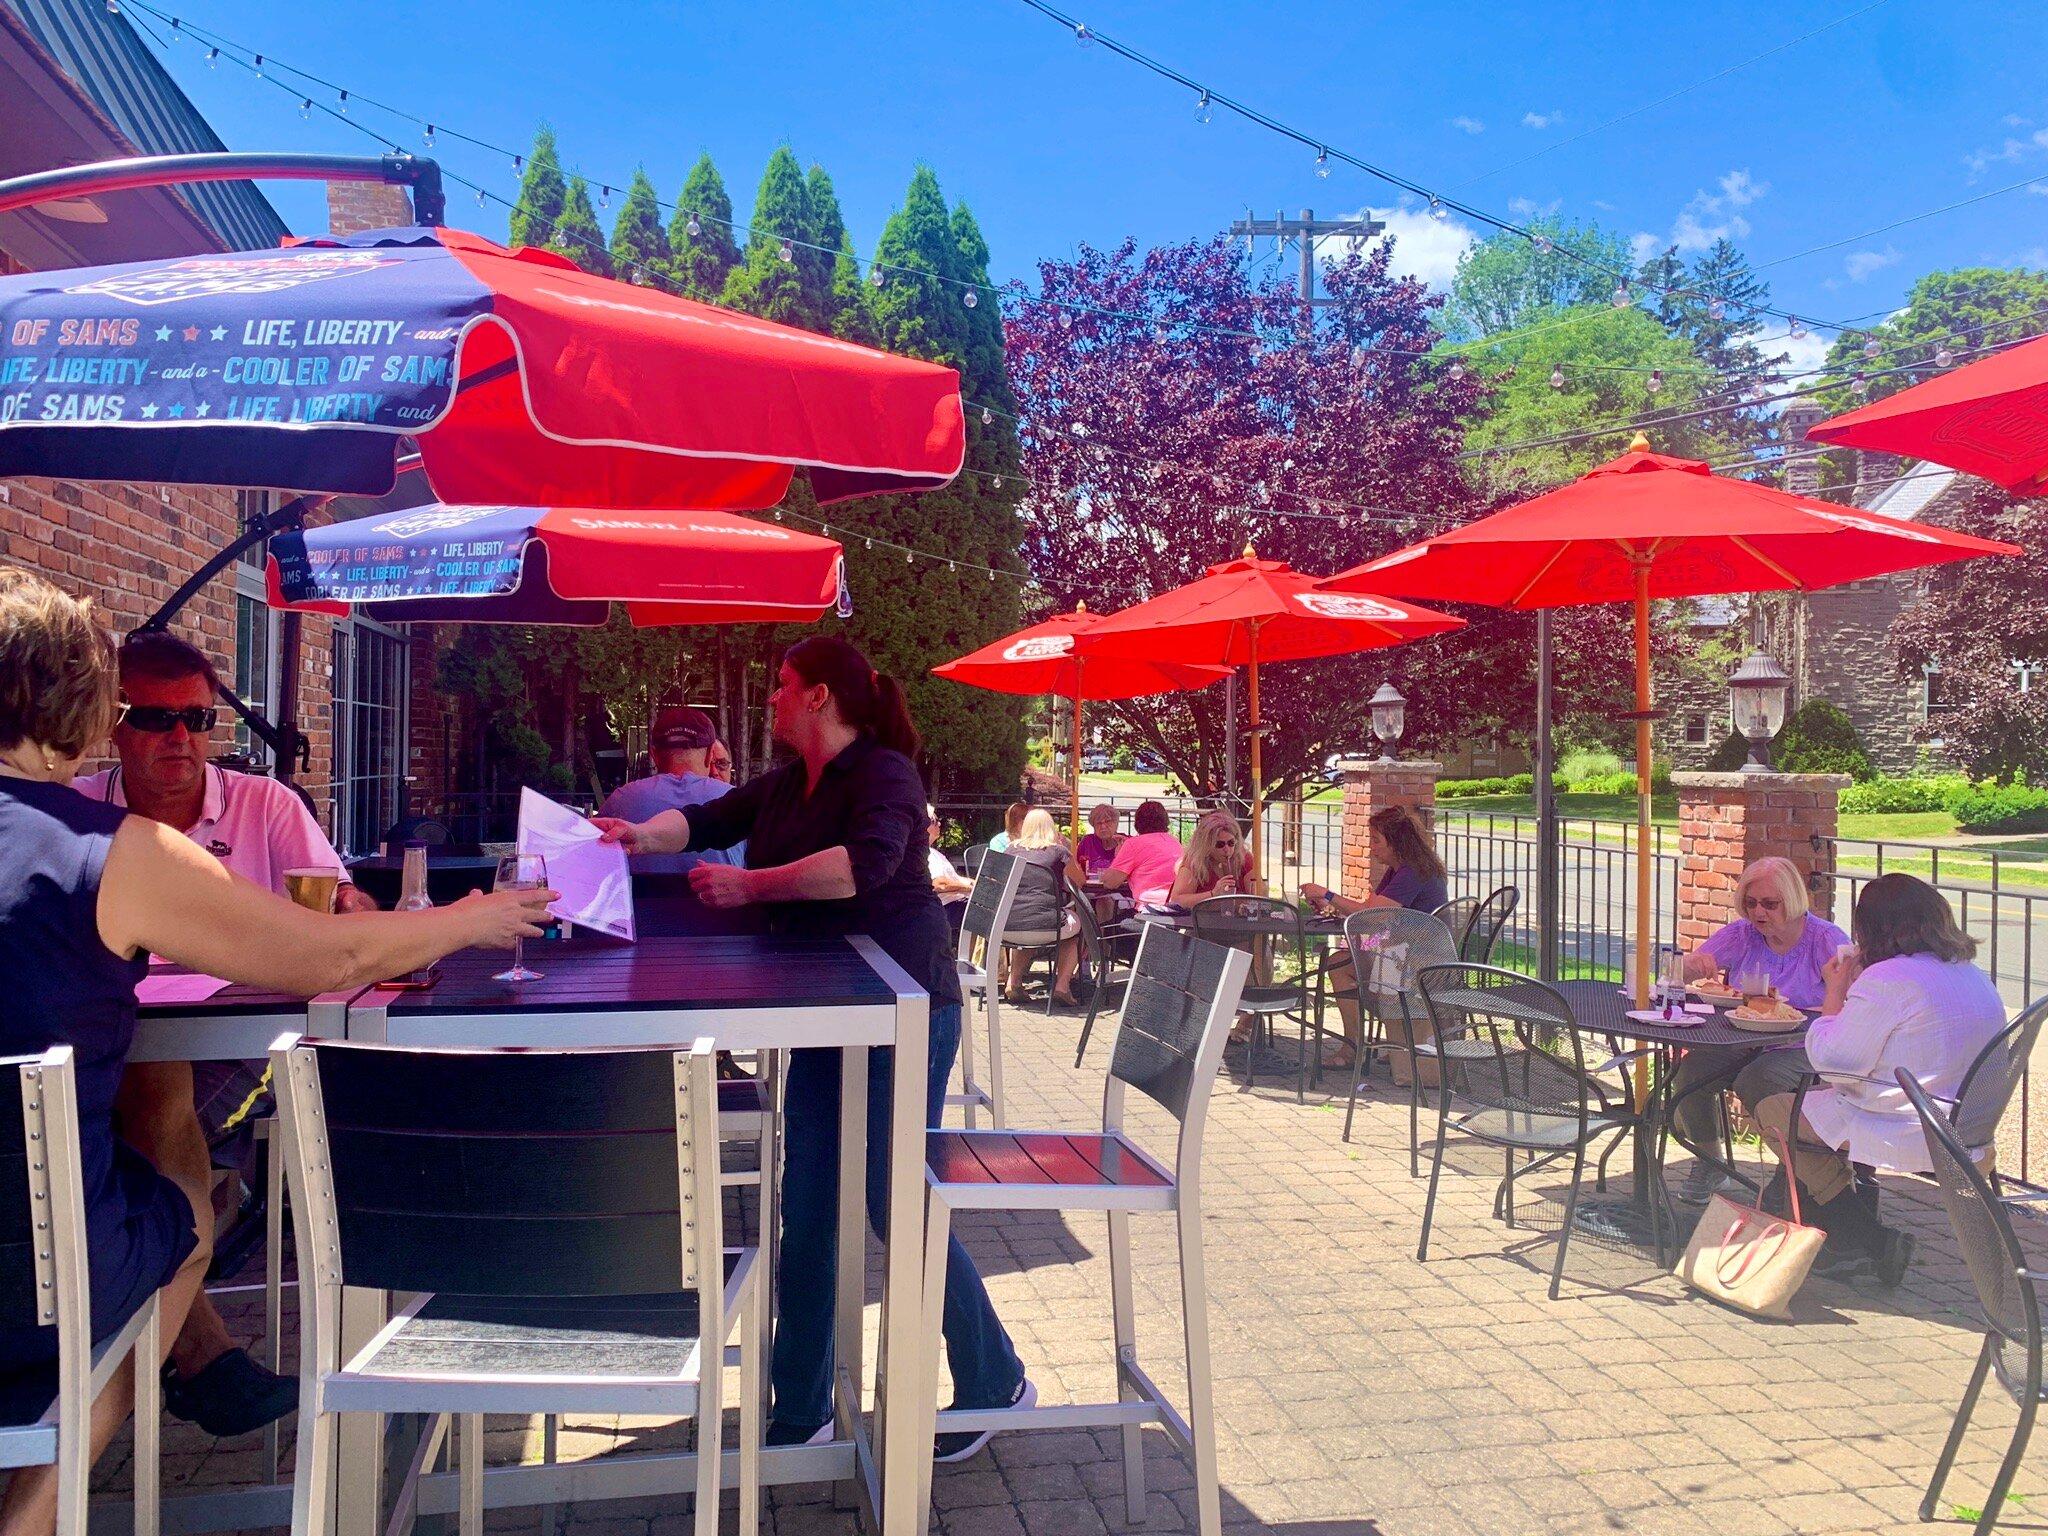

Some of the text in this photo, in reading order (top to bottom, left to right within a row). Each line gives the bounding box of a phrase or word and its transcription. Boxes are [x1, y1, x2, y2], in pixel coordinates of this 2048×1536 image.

[12, 318, 140, 346] OF SAMS
[243, 320, 296, 349] LIFE,
[303, 319, 404, 345] LIBERTY
[0, 356, 39, 386] IFE,
[45, 357, 149, 385] LIBERTY
[161, 363, 195, 379] and
[223, 356, 329, 385] COOLER
[338, 356, 374, 382] OF
[2, 392, 125, 422] OF SAMS
[289, 393, 383, 423] LIBERTY
[397, 404, 436, 420] and
[307, 548, 350, 564] COOLER
[354, 547, 368, 562] OF
[372, 545, 404, 560] SAMS
[443, 543, 466, 558] LIFE,
[467, 540, 504, 556] LIBERTY
[347, 567, 369, 582] LIFE,
[371, 565, 409, 580] LIBERTY
[436, 561, 479, 577] COOLER
[483, 560, 495, 575] OF
[305, 584, 401, 600] COOLER OF SAMS
